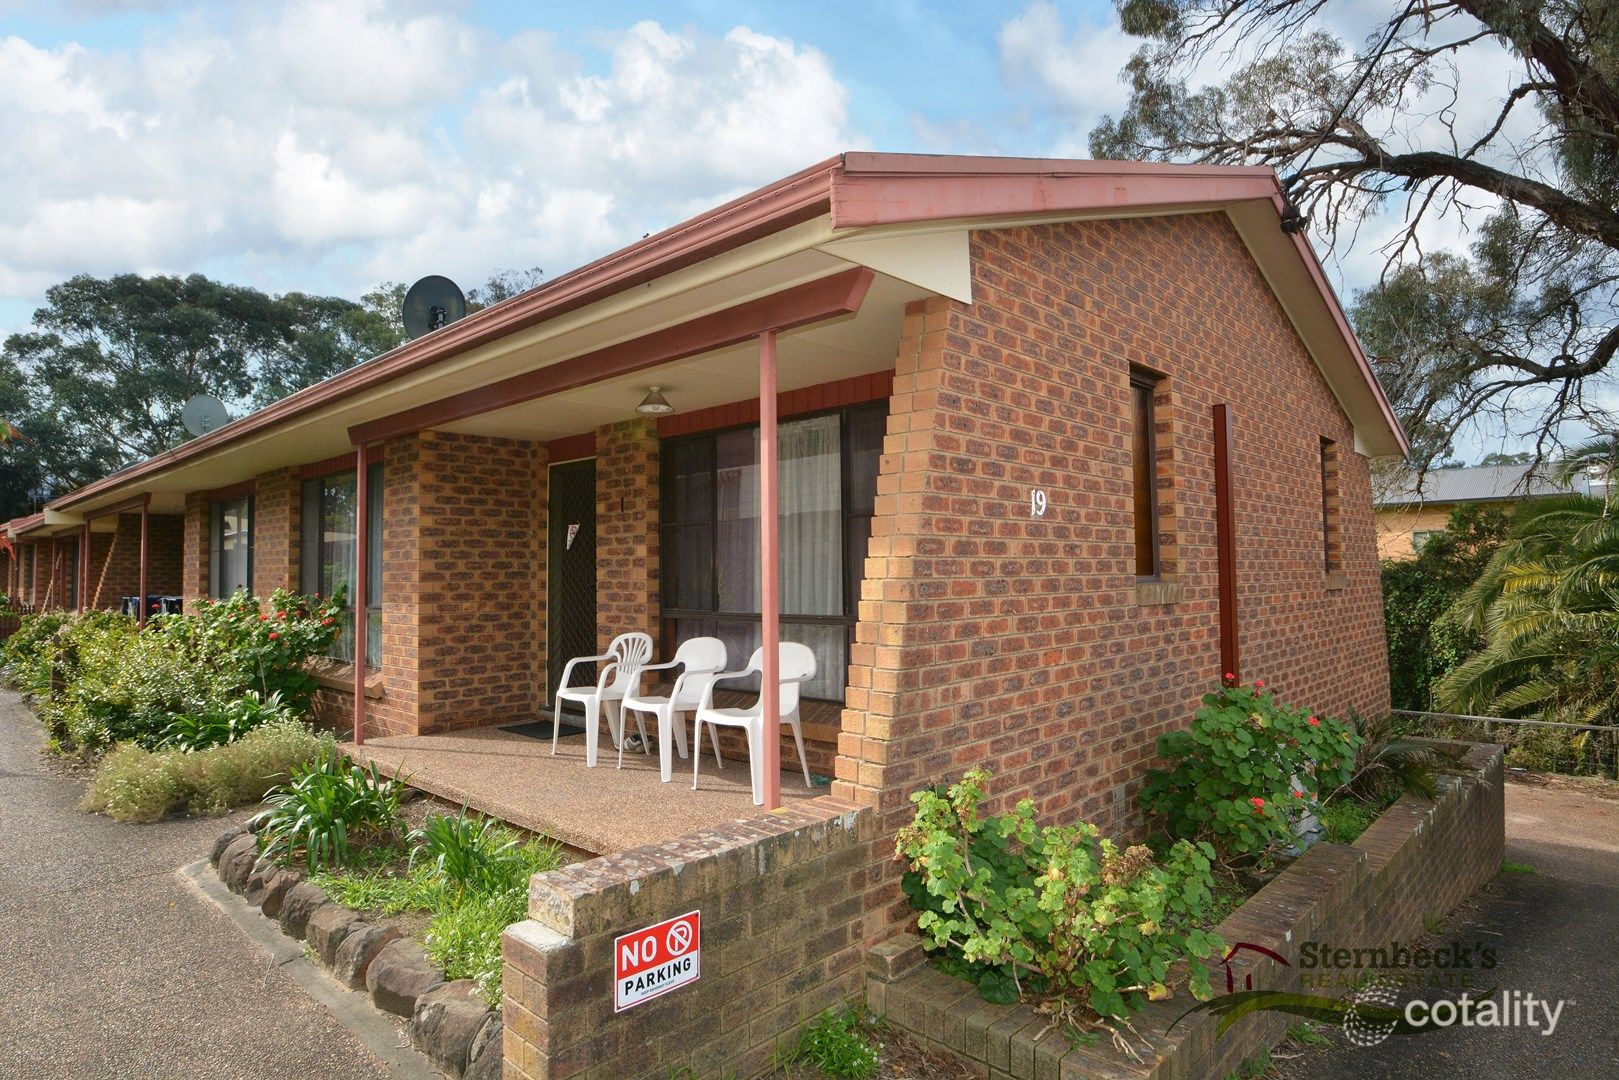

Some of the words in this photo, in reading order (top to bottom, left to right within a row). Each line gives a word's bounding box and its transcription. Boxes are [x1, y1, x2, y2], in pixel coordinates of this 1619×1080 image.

[1031, 489, 1047, 516] 19
[621, 935, 658, 972] NO
[624, 957, 692, 996] PARKING
